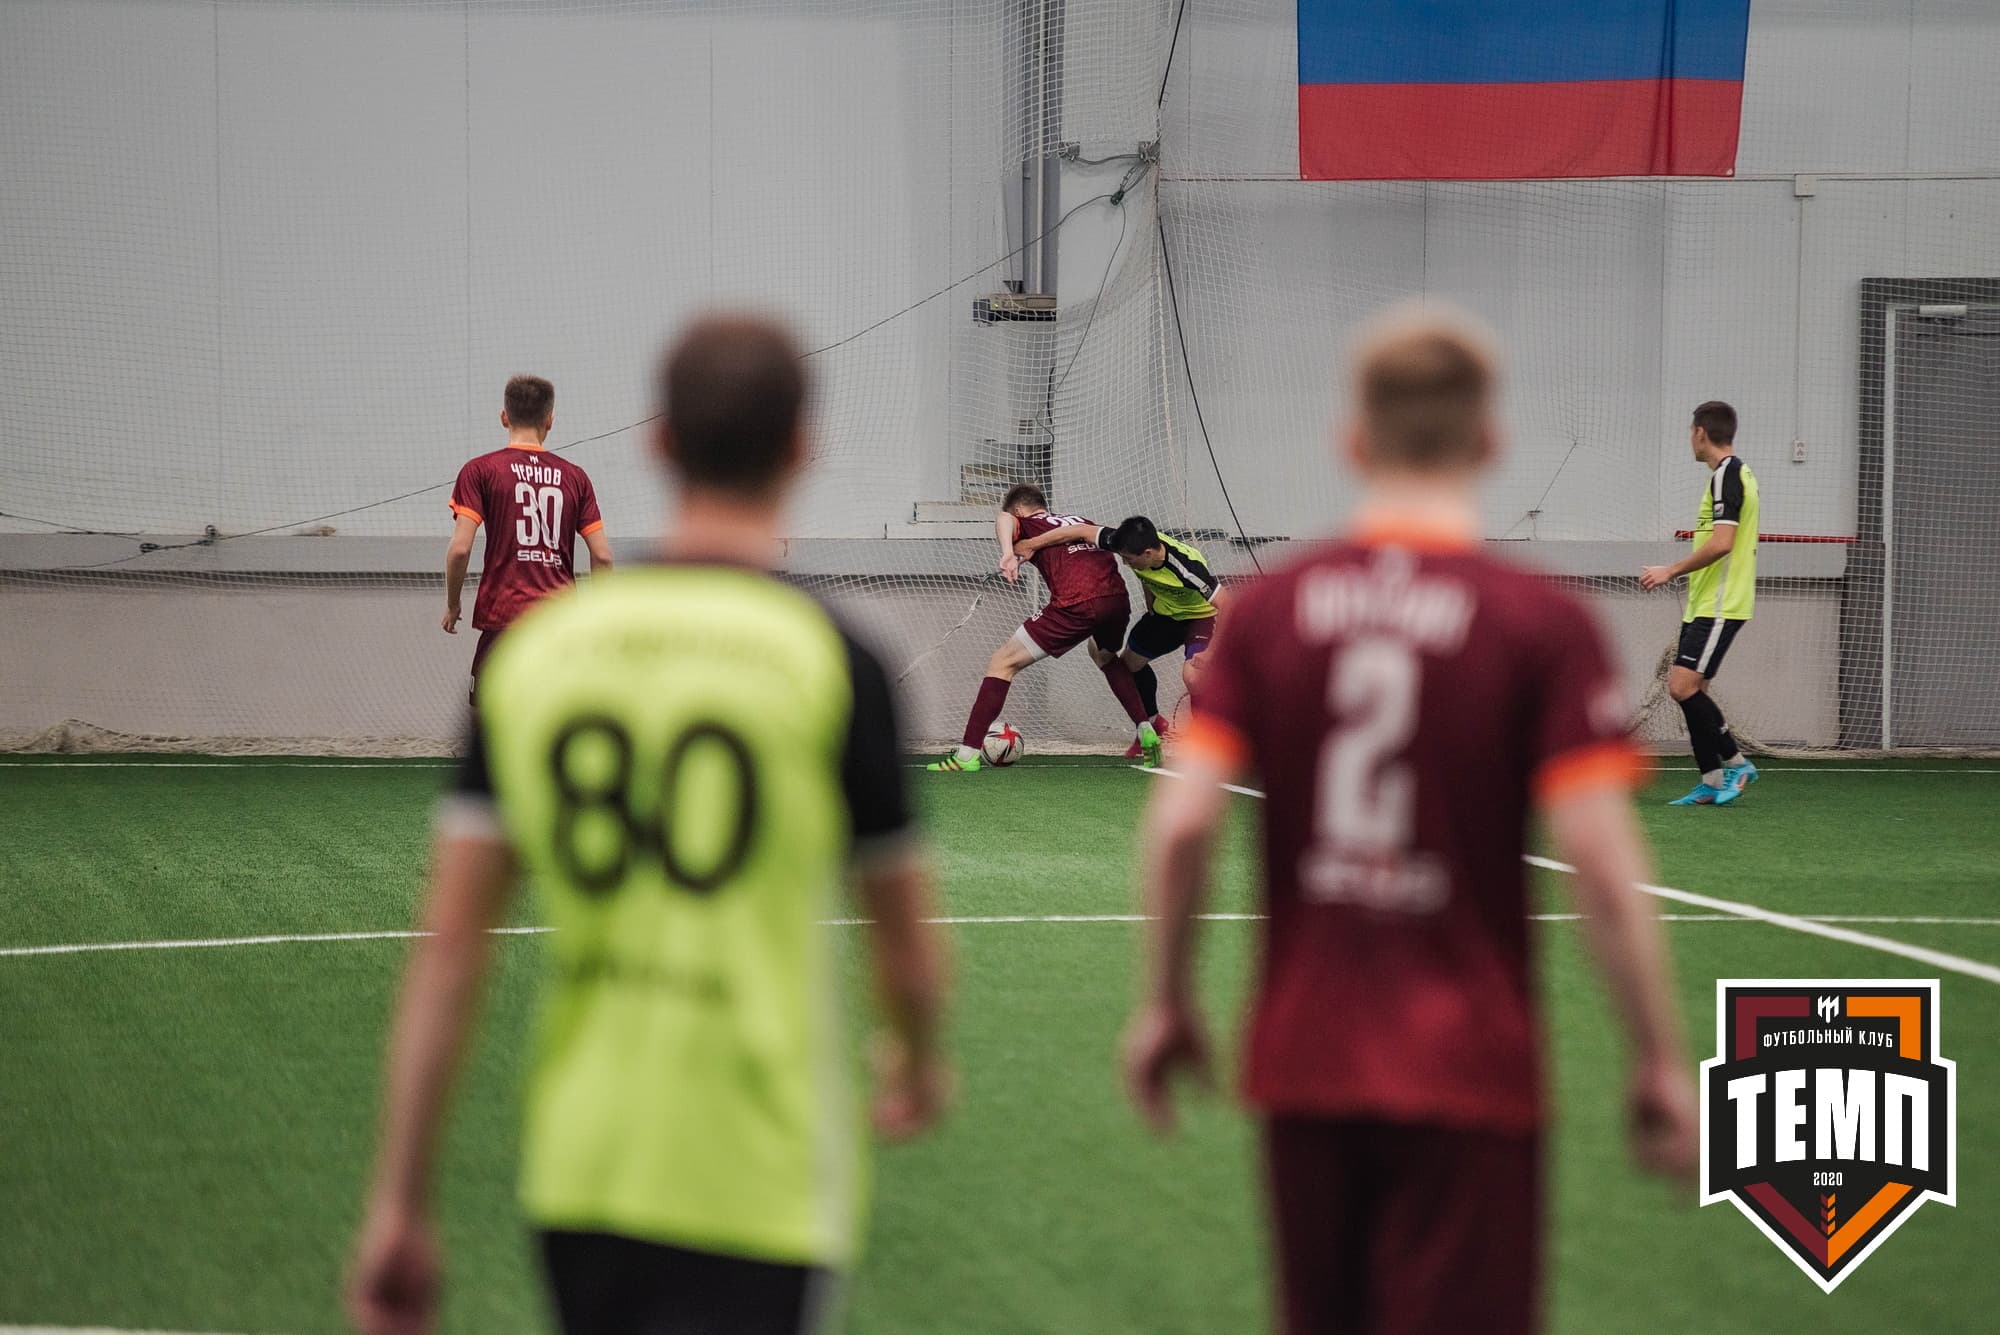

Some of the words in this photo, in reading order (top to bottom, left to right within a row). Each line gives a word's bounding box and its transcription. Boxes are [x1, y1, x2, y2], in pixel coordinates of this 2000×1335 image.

[511, 463, 562, 486] ЧЕРНОВ
[515, 482, 563, 550] 30
[549, 714, 760, 897] 80
[1318, 640, 1421, 850] 2
